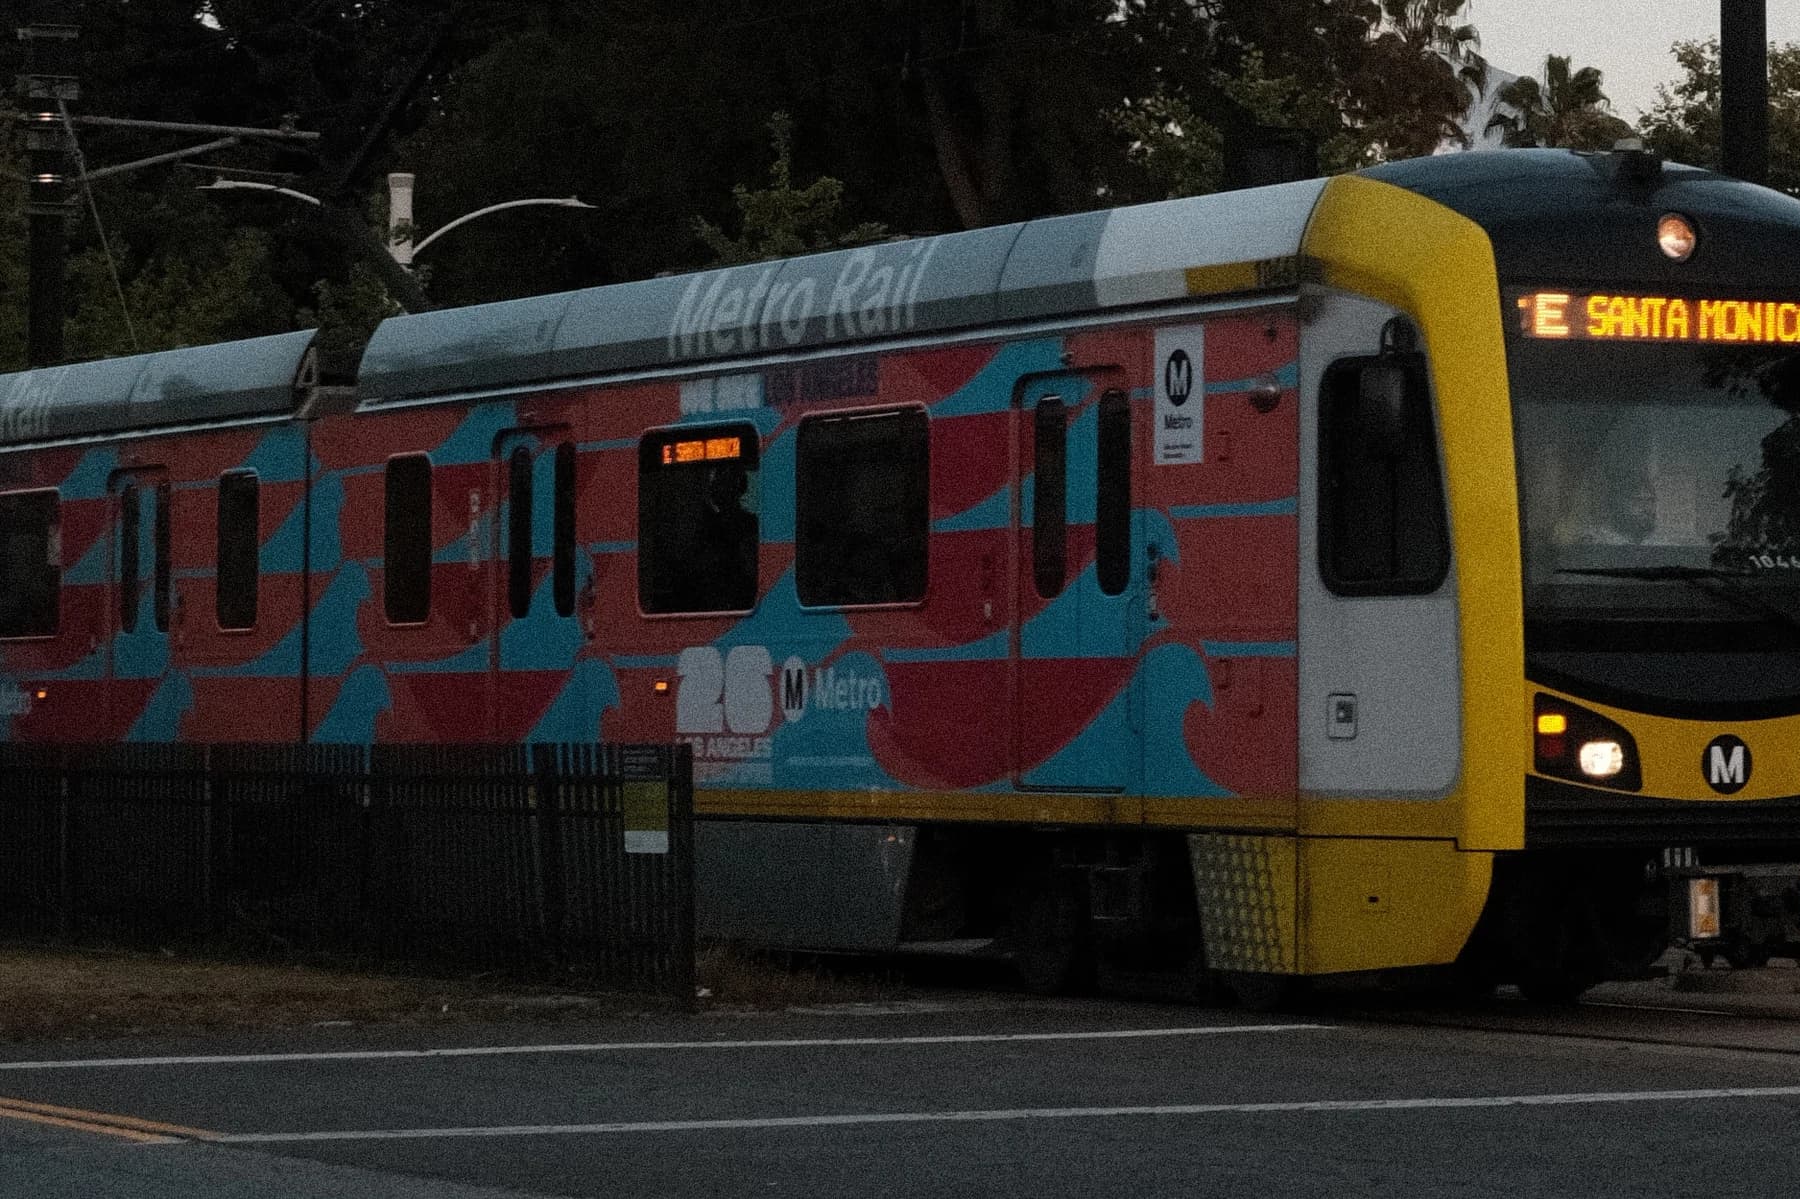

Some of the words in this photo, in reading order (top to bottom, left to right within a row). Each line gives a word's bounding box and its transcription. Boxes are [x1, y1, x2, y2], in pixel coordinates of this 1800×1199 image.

[668, 266, 818, 359] Metro
[826, 237, 940, 341] Rail
[1535, 293, 1569, 335] E
[1586, 295, 1688, 338] SANTA
[1164, 415, 1193, 430] Metro
[815, 667, 882, 710] Metro
